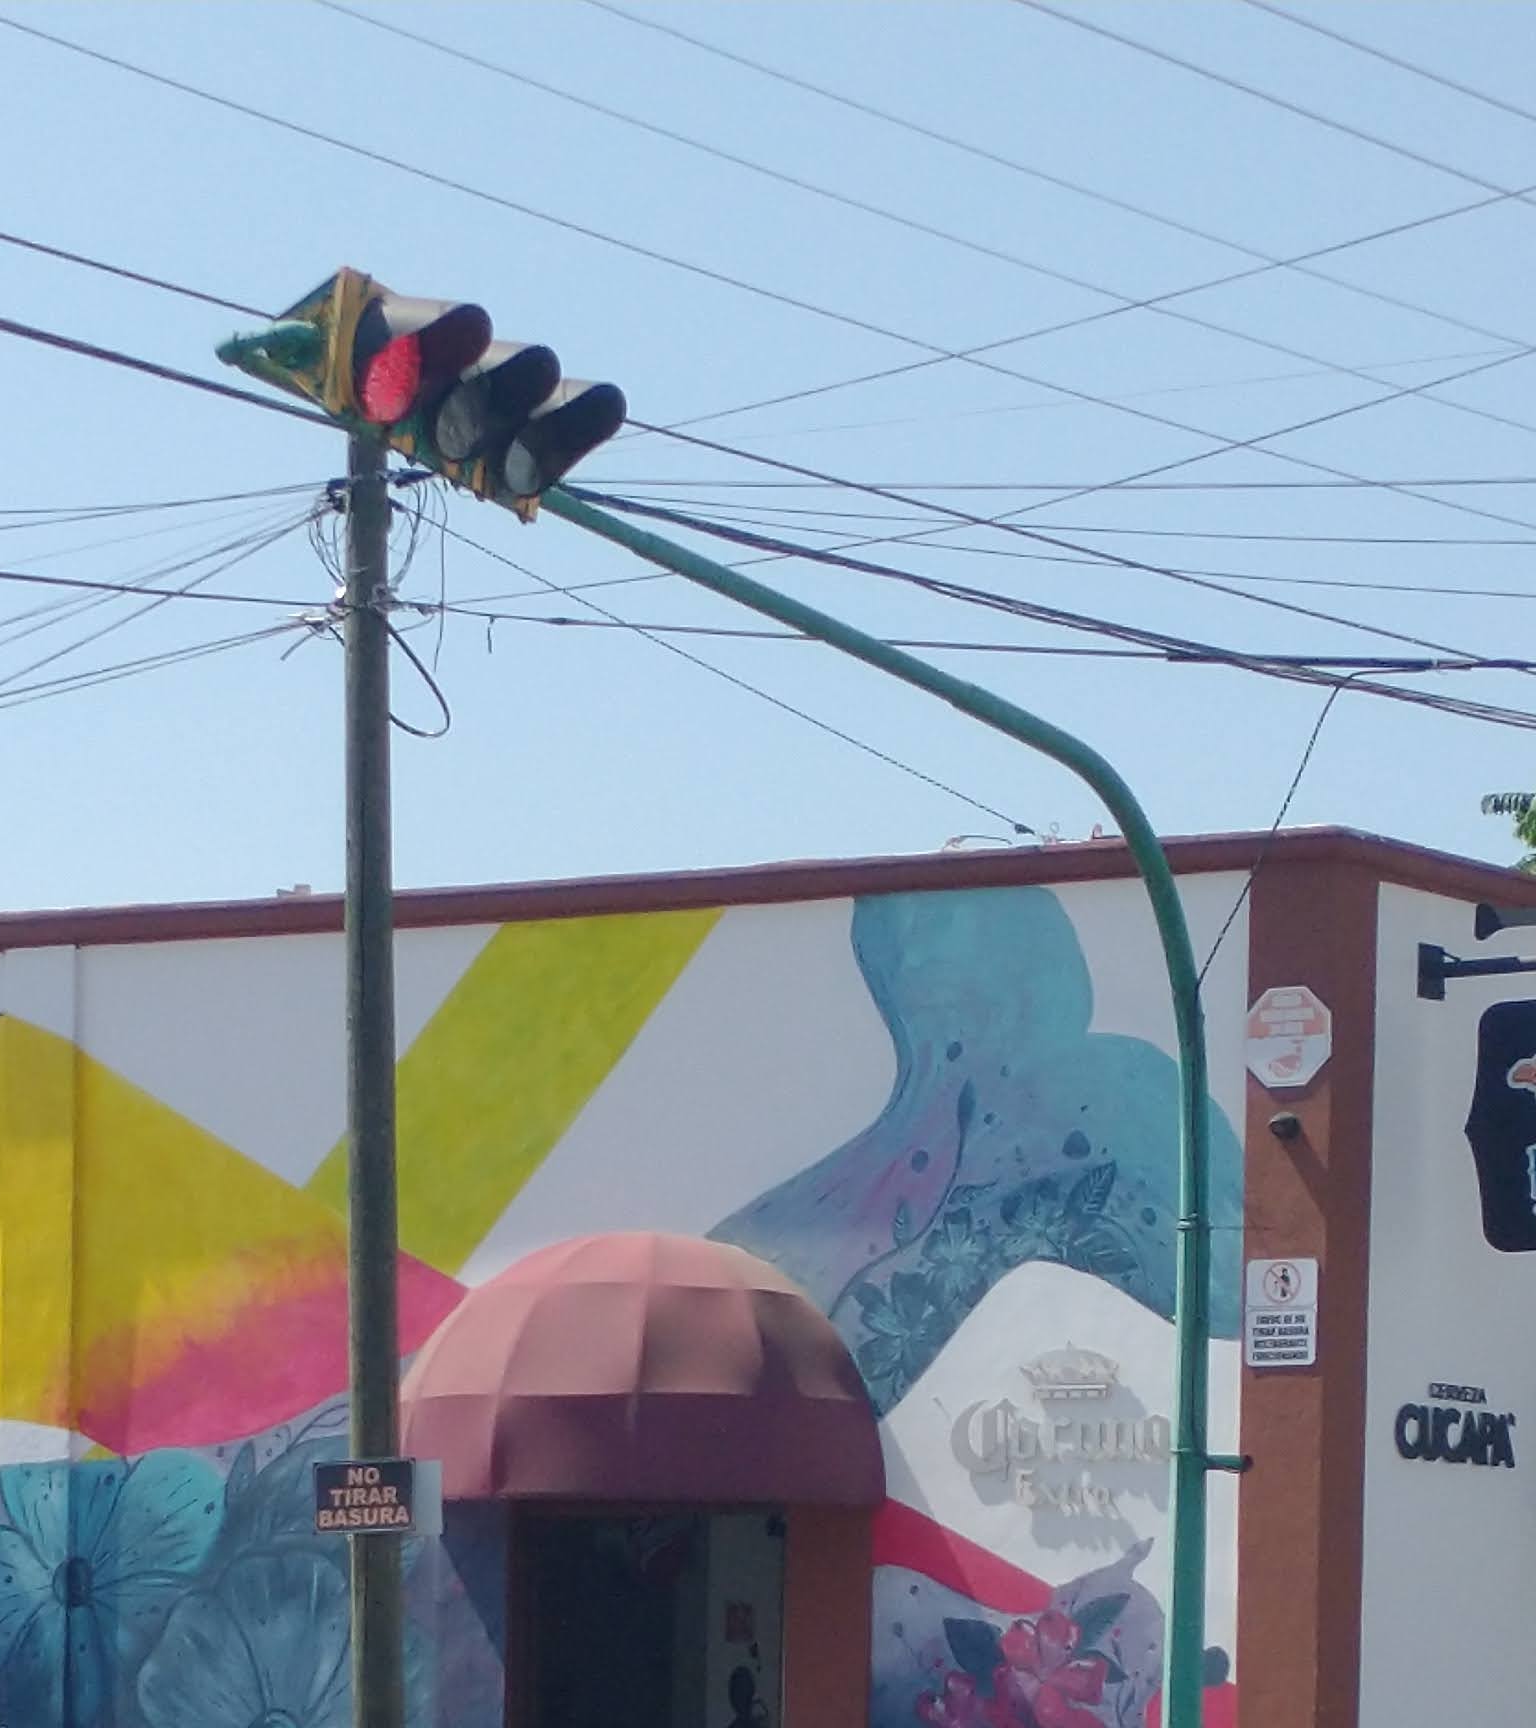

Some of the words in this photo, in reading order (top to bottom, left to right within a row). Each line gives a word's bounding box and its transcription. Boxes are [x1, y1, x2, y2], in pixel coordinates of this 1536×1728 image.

[951, 1398, 1172, 1482] Corona
[347, 1467, 381, 1486] NO
[329, 1485, 399, 1507] TIRAR
[318, 1505, 410, 1528] BASURA
